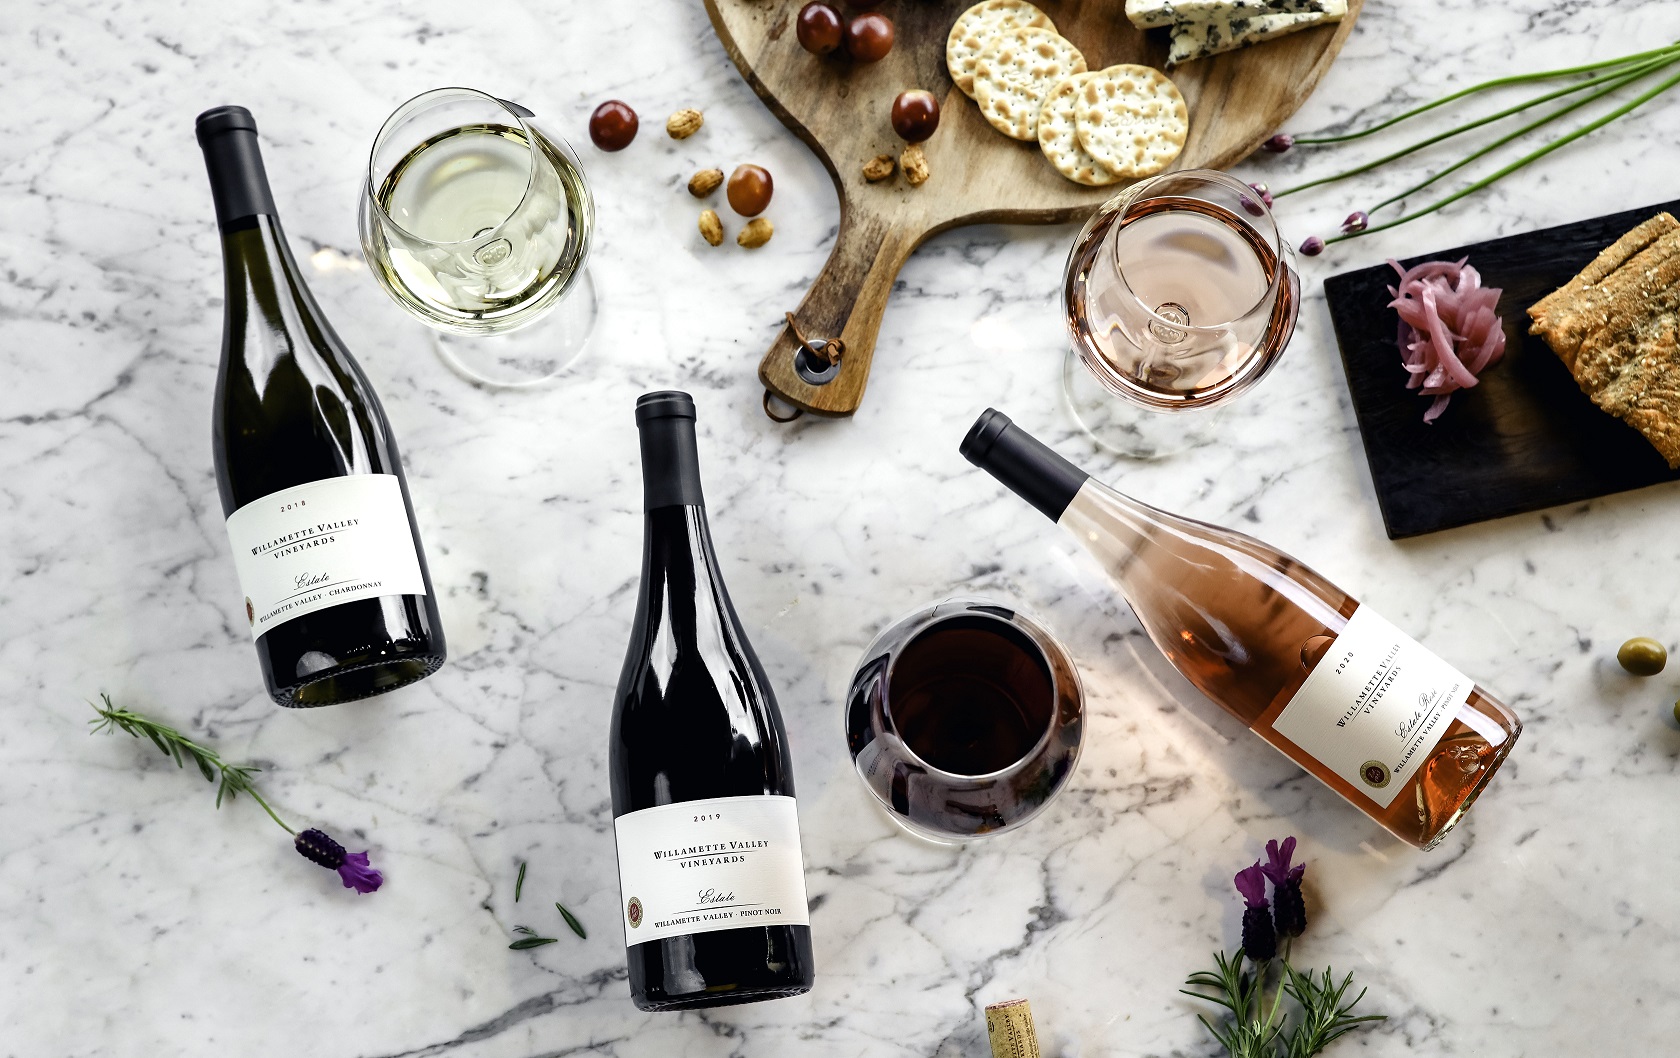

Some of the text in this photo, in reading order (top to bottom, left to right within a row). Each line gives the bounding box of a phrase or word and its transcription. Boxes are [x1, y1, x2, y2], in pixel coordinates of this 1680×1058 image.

[281, 500, 306, 513] 2018
[251, 518, 359, 556] WILLAMETTE VALLEY
[273, 535, 336, 559] VINEYARDS
[293, 571, 330, 591] Estate
[260, 581, 382, 623] WILLAMETTE VALLEY CHARDONNAY
[1335, 651, 1354, 675] 2020
[1336, 669, 1383, 728] WILLAMETTE
[1363, 665, 1402, 715] VINEYARDS
[1394, 710, 1422, 743] Estate
[1393, 735, 1425, 774] WILLAMETTE
[1422, 711, 1441, 736] VALLEY
[693, 813, 721, 822] 2019
[653, 840, 770, 860] WILLAMETTE VALLEY
[680, 855, 745, 869] VINEYARDS
[695, 887, 736, 905] Estate
[654, 916, 701, 929] WILLAMETTE
[703, 911, 734, 921] VALLEY
[740, 909, 763, 917] PINOT
